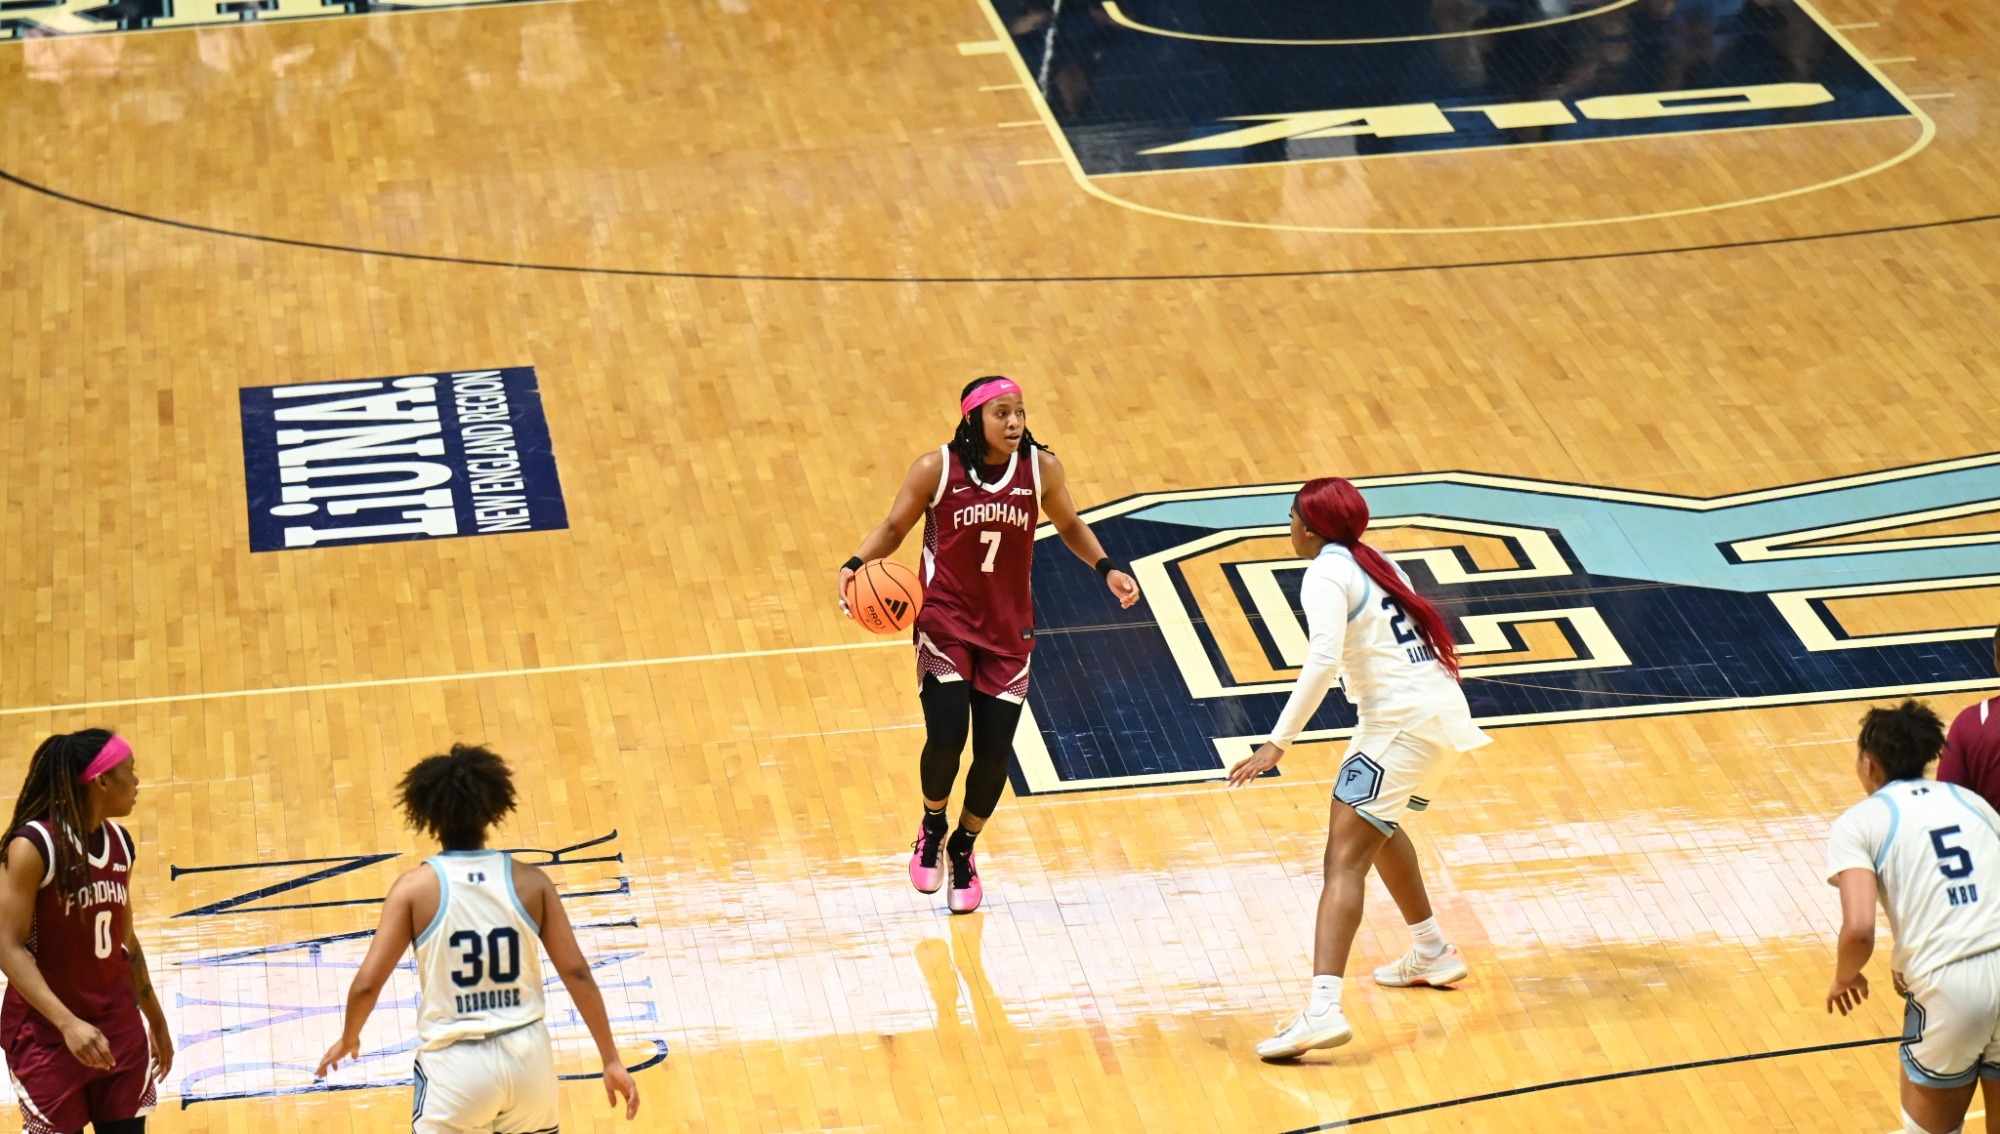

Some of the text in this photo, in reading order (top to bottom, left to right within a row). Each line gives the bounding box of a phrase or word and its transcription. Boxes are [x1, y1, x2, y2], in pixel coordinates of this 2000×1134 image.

[451, 370, 531, 532] NEW ENGLAND REGION
[953, 502, 1029, 531] FORDHAM
[979, 530, 1002, 573] 7
[1381, 596, 1424, 645] 2
[1928, 824, 1974, 880] 5
[65, 880, 127, 916] FORDHA
[1947, 884, 1978, 906] MBU
[95, 910, 112, 959] 0
[449, 927, 520, 988] 30
[455, 988, 520, 1014] DEBROISE
